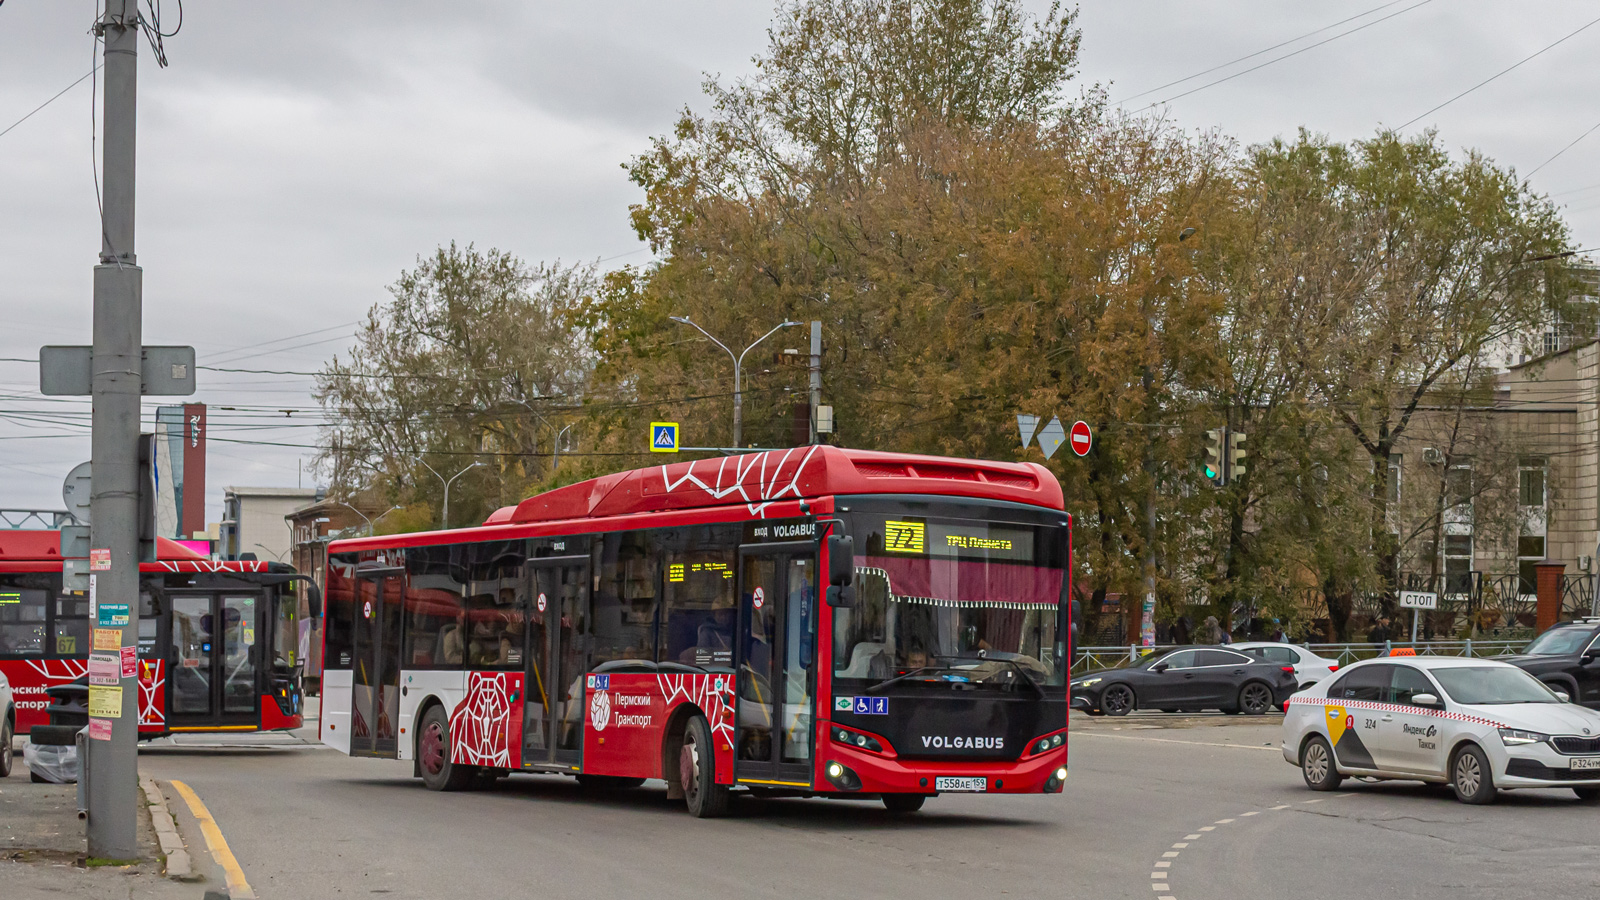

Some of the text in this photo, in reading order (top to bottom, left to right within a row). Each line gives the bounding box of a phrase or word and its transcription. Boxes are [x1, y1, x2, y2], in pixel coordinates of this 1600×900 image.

[892, 527, 915, 548] 72
[946, 535, 1012, 550] ТРЦ Планета
[1405, 594, 1432, 606] СТОП
[58, 639, 75, 653] 67
[614, 692, 651, 709] Пермский
[614, 711, 652, 729] Транспорт
[1365, 719, 1377, 729] 324
[1403, 723, 1437, 737] Яндекс Go
[922, 736, 1004, 749] VOLGABUS
[1418, 738, 1436, 750] Такси
